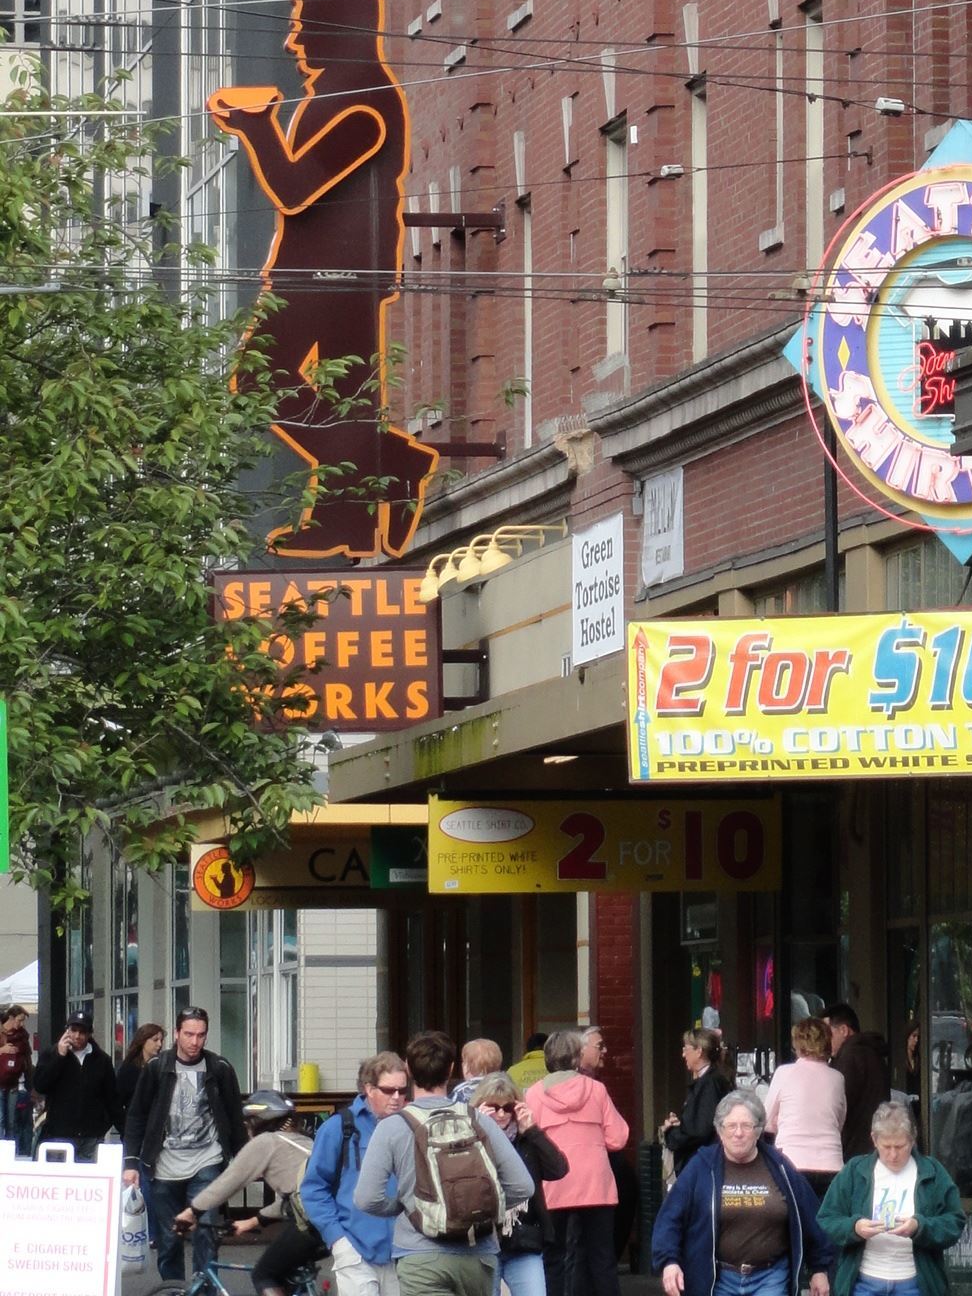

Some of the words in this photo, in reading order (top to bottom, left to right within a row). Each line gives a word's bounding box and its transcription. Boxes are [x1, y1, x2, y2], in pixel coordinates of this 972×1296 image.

[581, 536, 614, 569] Green
[223, 578, 428, 620] SEATTLE
[575, 571, 621, 610] Tortoise
[580, 606, 616, 647] Hostel
[656, 634, 717, 717] 2
[724, 630, 852, 716] for
[656, 724, 774, 756] 100%
[781, 721, 958, 754] COTTON
[656, 756, 850, 774] PREPRINTED
[857, 753, 959, 770] WHITE
[446, 819, 481, 831] SEATTLE
[486, 819, 511, 831] SHIRT
[437, 851, 505, 865] PRE-PRINTED
[509, 850, 538, 863] WHITE
[556, 811, 608, 880] 2
[619, 840, 672, 867] FOR
[308, 847, 370, 883] CA
[449, 865, 489, 876] SHIRTS
[494, 864, 527, 876] ONLY!
[6, 1184, 59, 1201] SMOKE
[65, 1187, 104, 1202] PLUS
[7, 1258, 60, 1272] SWEDISH
[62, 1261, 94, 1273] SNUS
[27, 1242, 89, 1256] CIGARETTE
